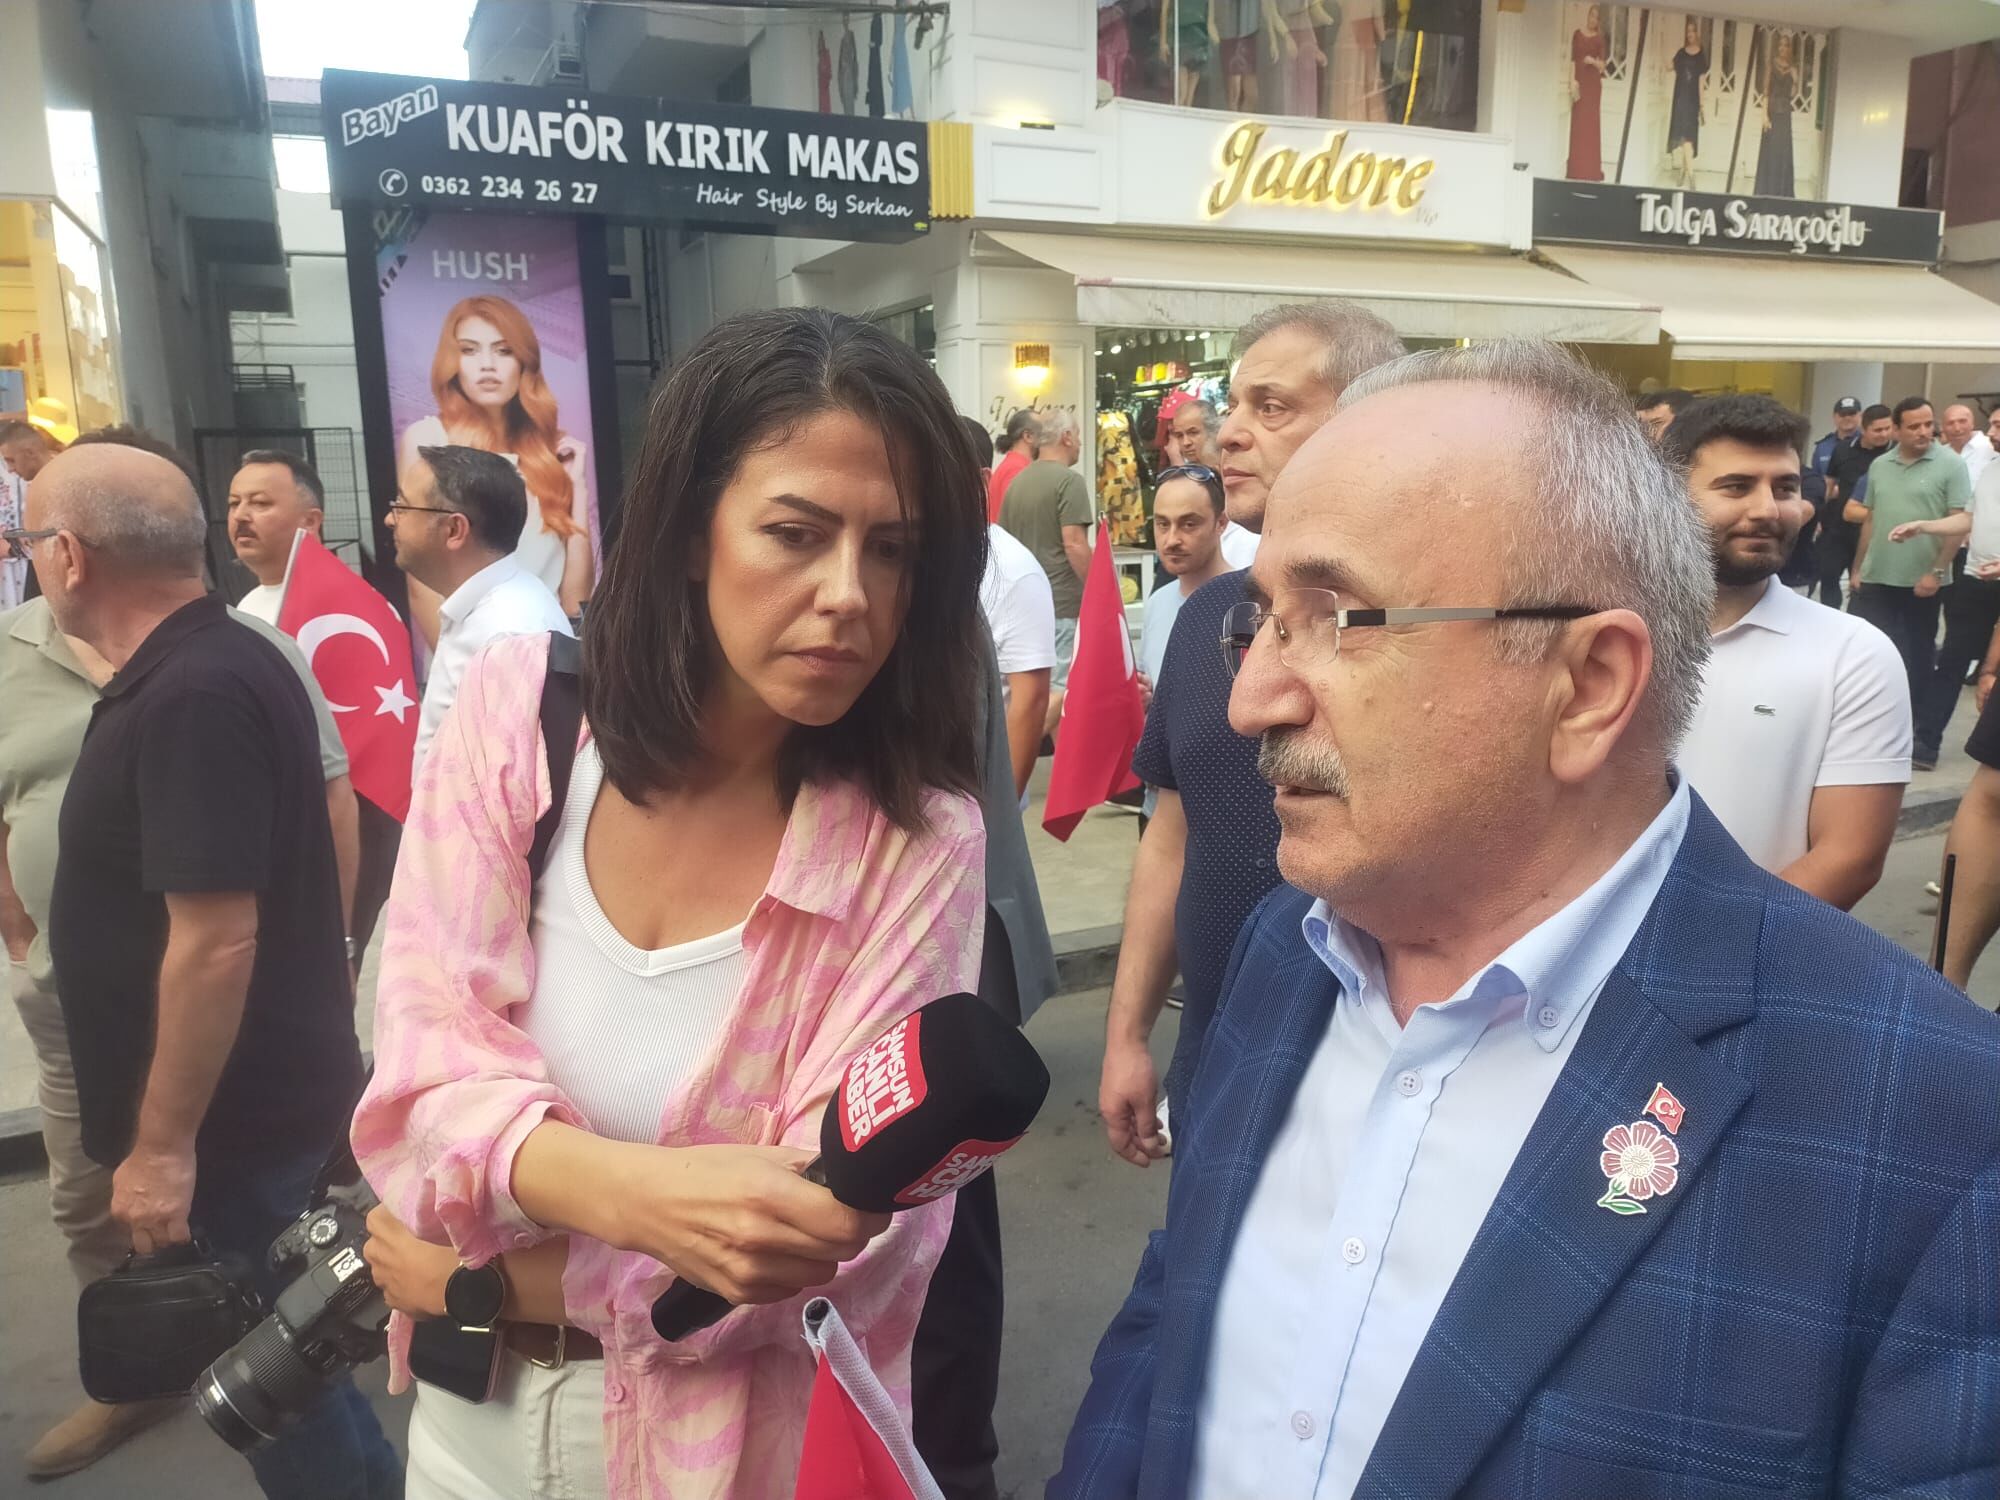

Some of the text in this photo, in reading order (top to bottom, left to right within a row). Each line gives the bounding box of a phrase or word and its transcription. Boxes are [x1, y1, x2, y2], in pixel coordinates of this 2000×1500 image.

[341, 84, 438, 147] Bayan
[446, 98, 920, 185] KUAFÖR KIRIK MAKAS
[421, 175, 598, 204] 0362 234 26 27
[696, 182, 914, 219] Hair Style By Serkan
[432, 249, 529, 281] HUSH
[846, 1047, 872, 1146] HABER
[865, 1033, 896, 1128] CANLI
[887, 1019, 915, 1113] SAMSUN
